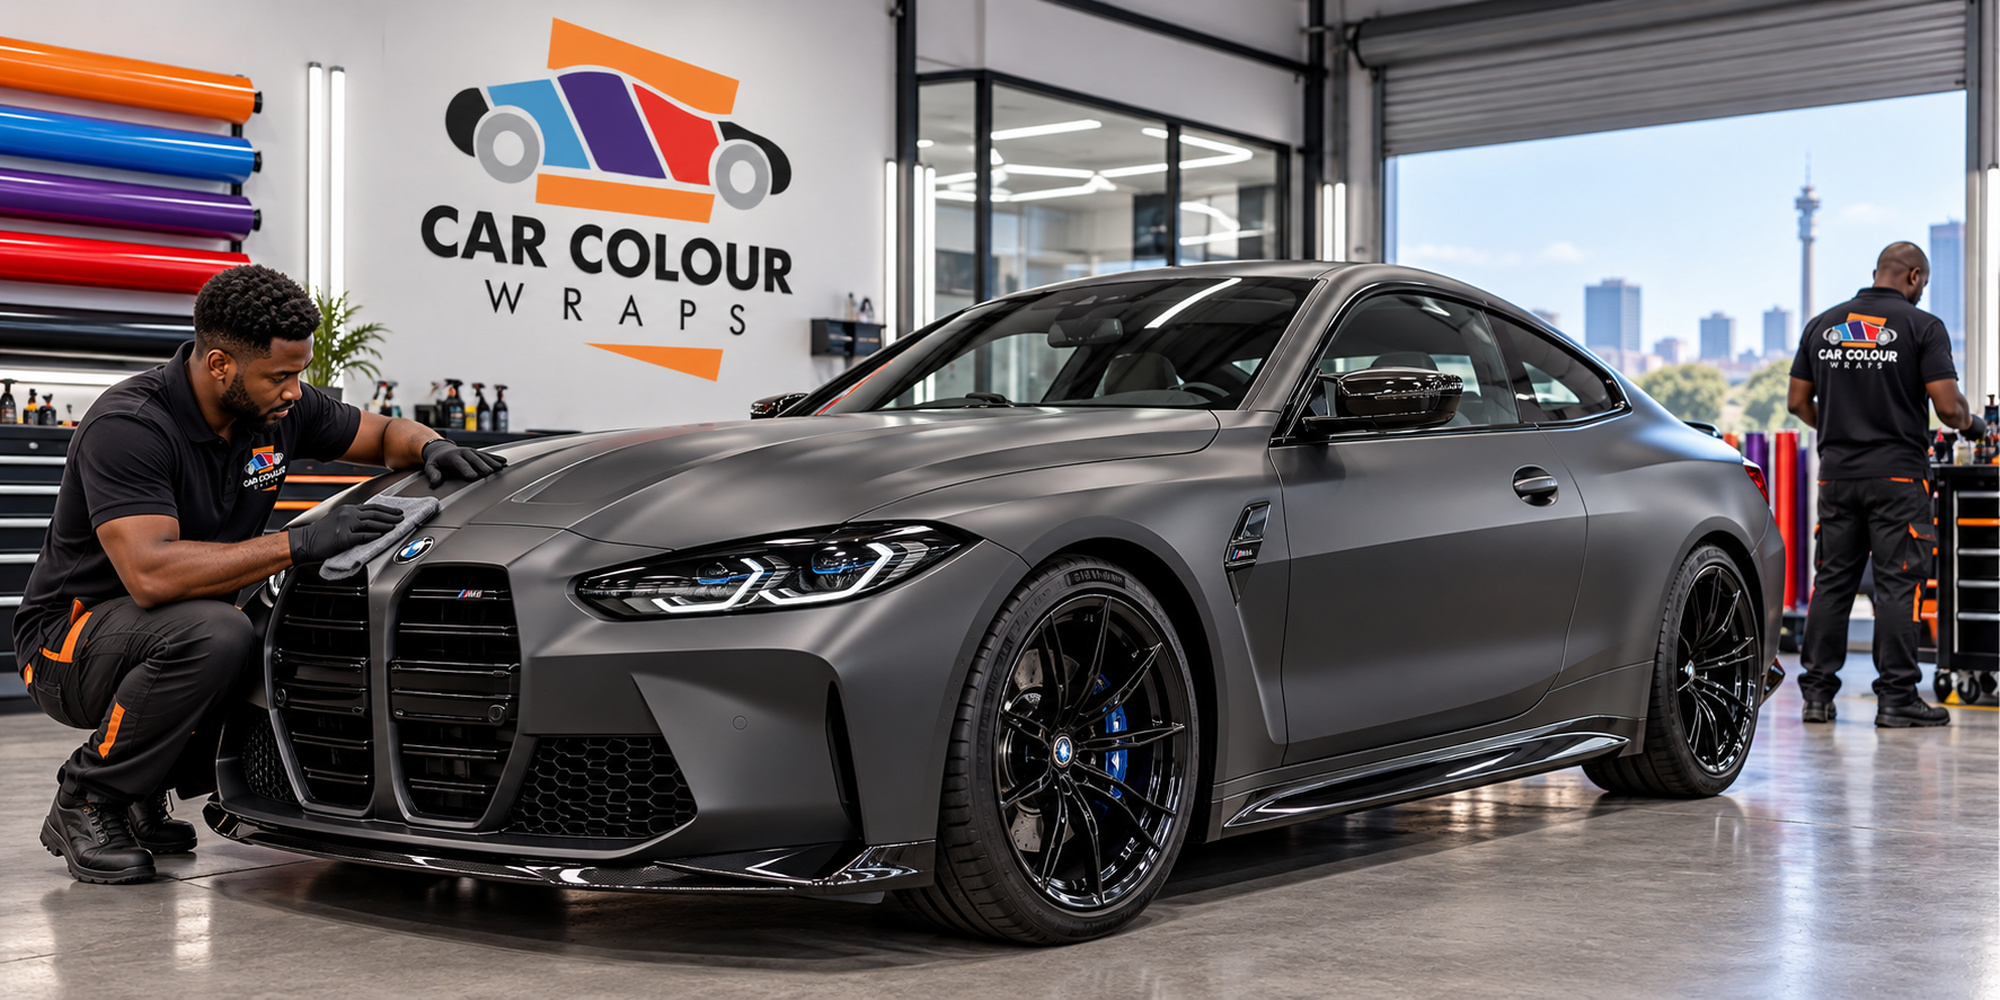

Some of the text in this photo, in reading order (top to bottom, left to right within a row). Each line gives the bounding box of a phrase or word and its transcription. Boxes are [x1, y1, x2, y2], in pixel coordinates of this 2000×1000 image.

[421, 205, 793, 295] CAR COLOUR
[484, 279, 746, 336] WRAPS
[1818, 348, 1898, 362] CAR COLOUR
[1829, 361, 1883, 369] WRAPS
